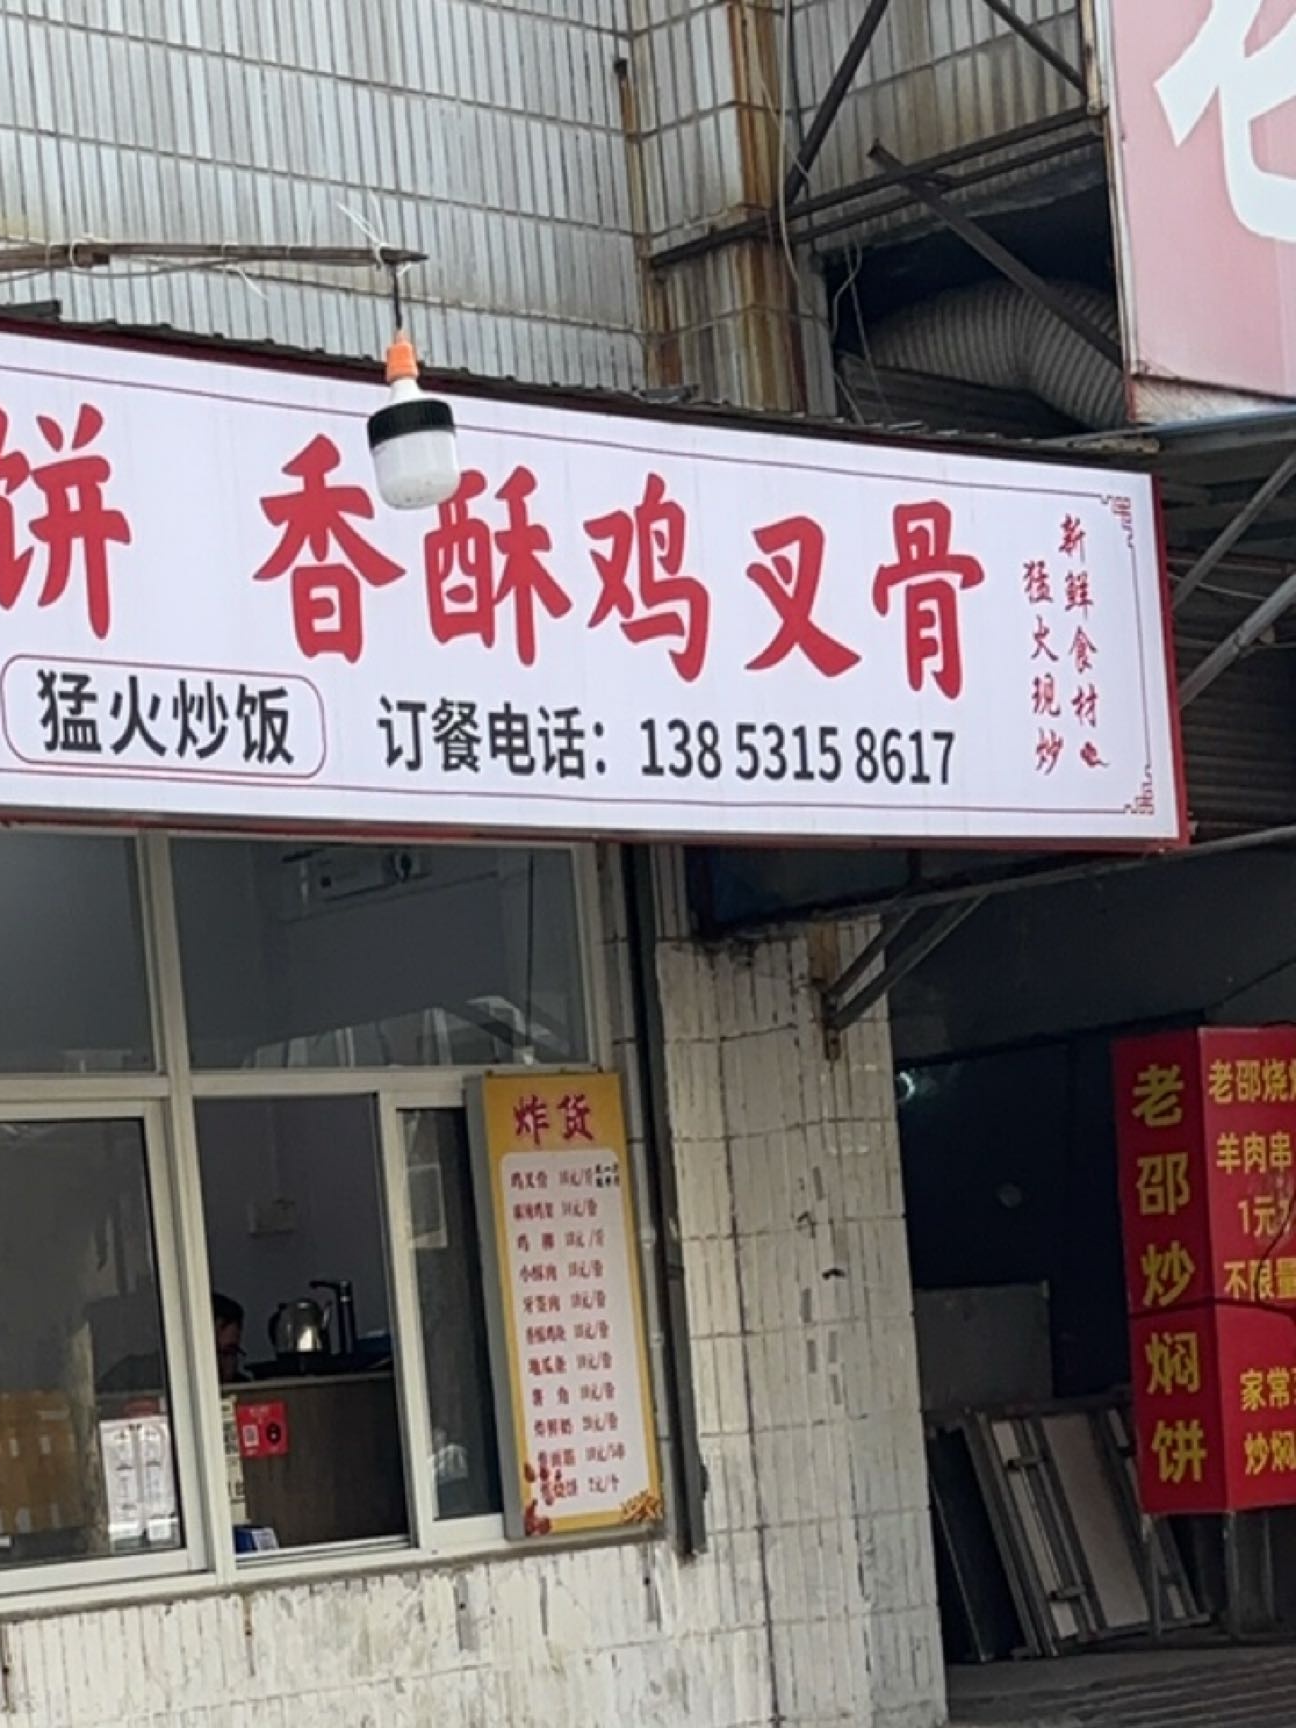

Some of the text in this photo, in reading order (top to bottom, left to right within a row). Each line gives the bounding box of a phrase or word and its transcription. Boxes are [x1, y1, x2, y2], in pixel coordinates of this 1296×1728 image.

[254, 433, 985, 699] 香酥鸡叉骨
[1059, 513, 1098, 728] 新鲜食材
[36, 669, 296, 765] 猛火炒饭
[1023, 560, 1065, 776] 猛火现炒
[640, 717, 722, 779] 138
[735, 722, 843, 782] 5315
[854, 726, 957, 785] 8617
[513, 1093, 594, 1145] 炸货
[1216, 1130, 1293, 1175] 羊肉串
[1132, 1063, 1208, 1484] 老邵炒焖饼
